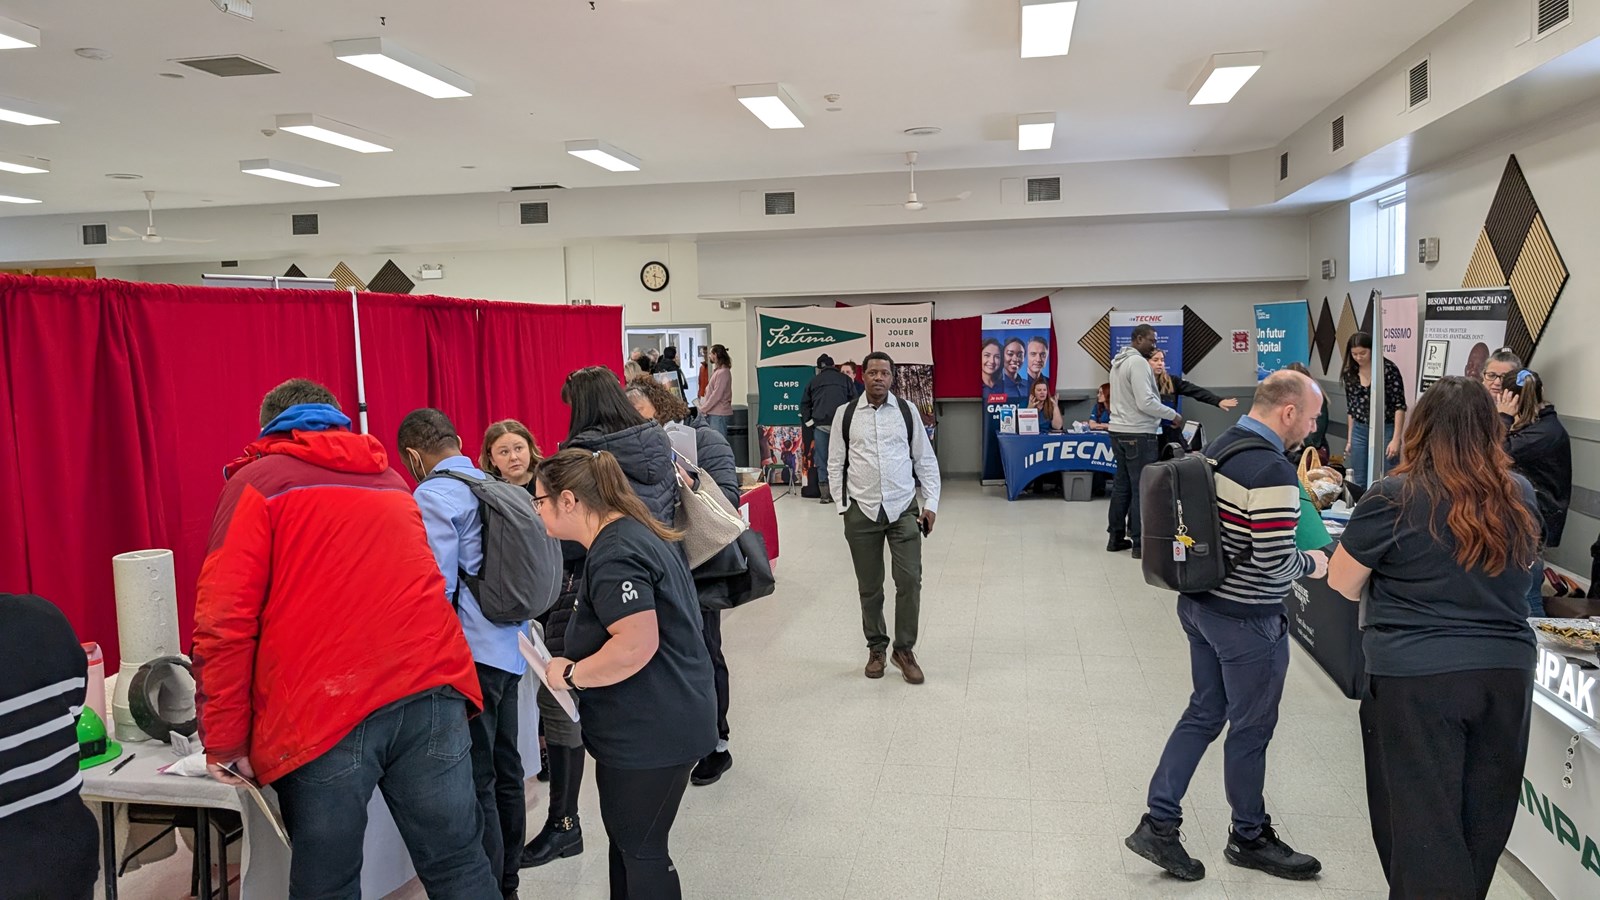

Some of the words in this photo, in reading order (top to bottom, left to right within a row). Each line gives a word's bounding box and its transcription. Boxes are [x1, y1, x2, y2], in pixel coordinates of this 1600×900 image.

[1428, 297, 1448, 306] BESOIN
[1464, 296, 1502, 304] GAGNE-PAIN
[767, 324, 836, 347] Fatima
[1266, 328, 1286, 338] futur
[1384, 328, 1412, 338] CISSSMO
